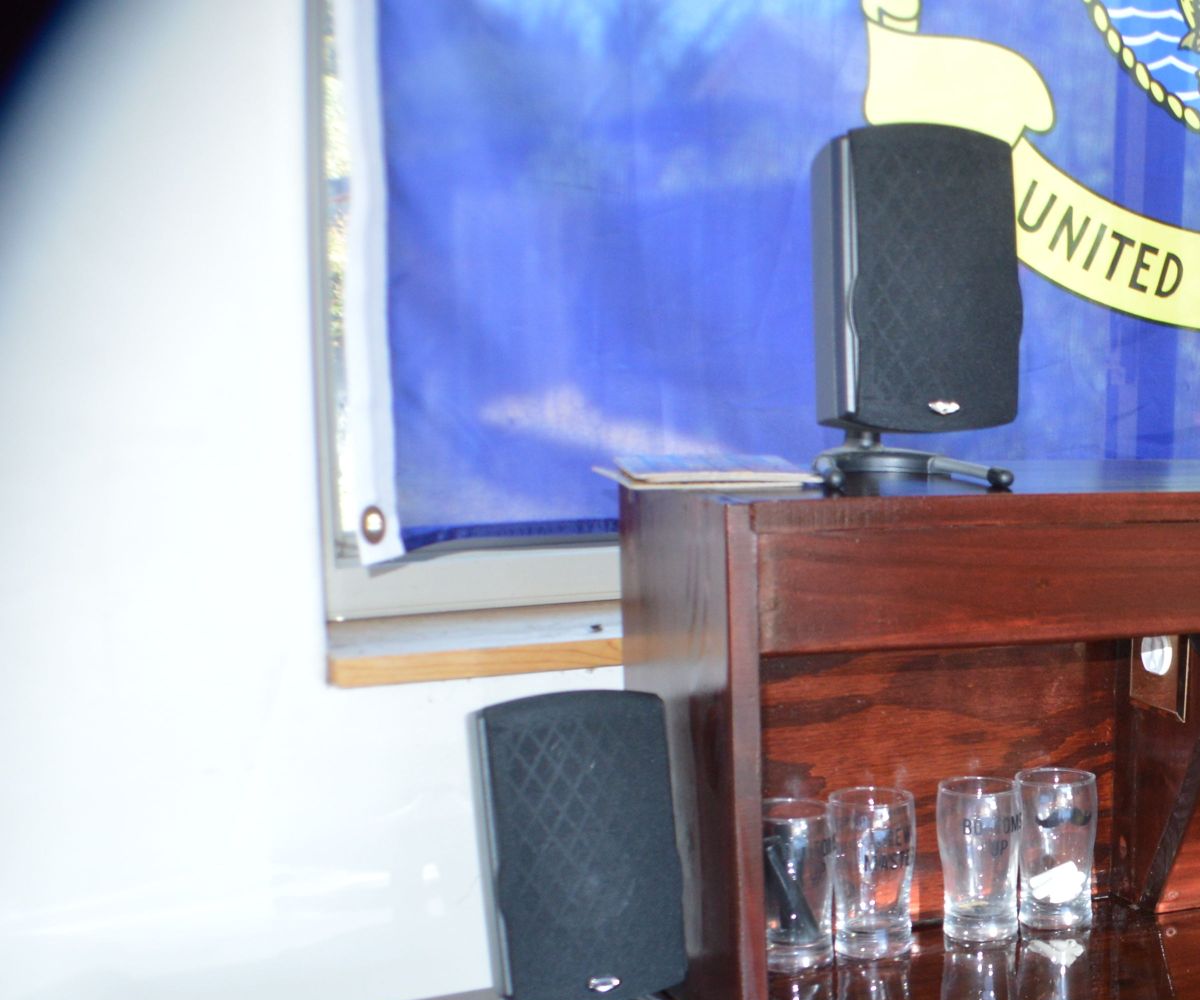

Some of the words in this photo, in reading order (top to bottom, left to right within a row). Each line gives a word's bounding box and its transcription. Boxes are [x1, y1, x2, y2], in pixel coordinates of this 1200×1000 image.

[1016, 179, 1184, 298] UNITED
[962, 812, 1022, 836] BOOMS
[991, 839, 1009, 857] UP
